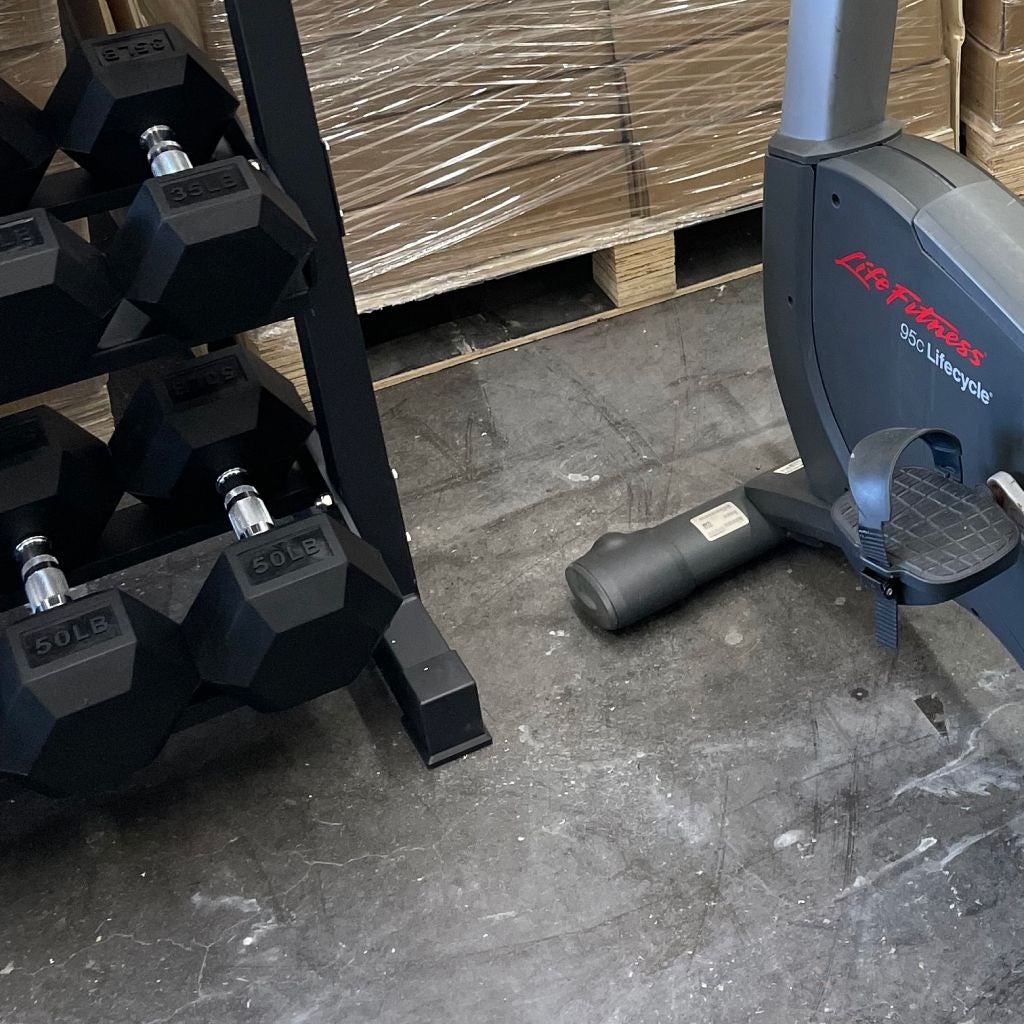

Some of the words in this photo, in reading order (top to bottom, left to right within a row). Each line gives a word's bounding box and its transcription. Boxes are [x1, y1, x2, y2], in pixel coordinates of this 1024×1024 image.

[835, 251, 890, 291] Life
[885, 283, 986, 367] Fitness
[926, 342, 991, 405] Lifecycle
[250, 536, 323, 575] 50LB
[34, 614, 110, 657] 50LB
